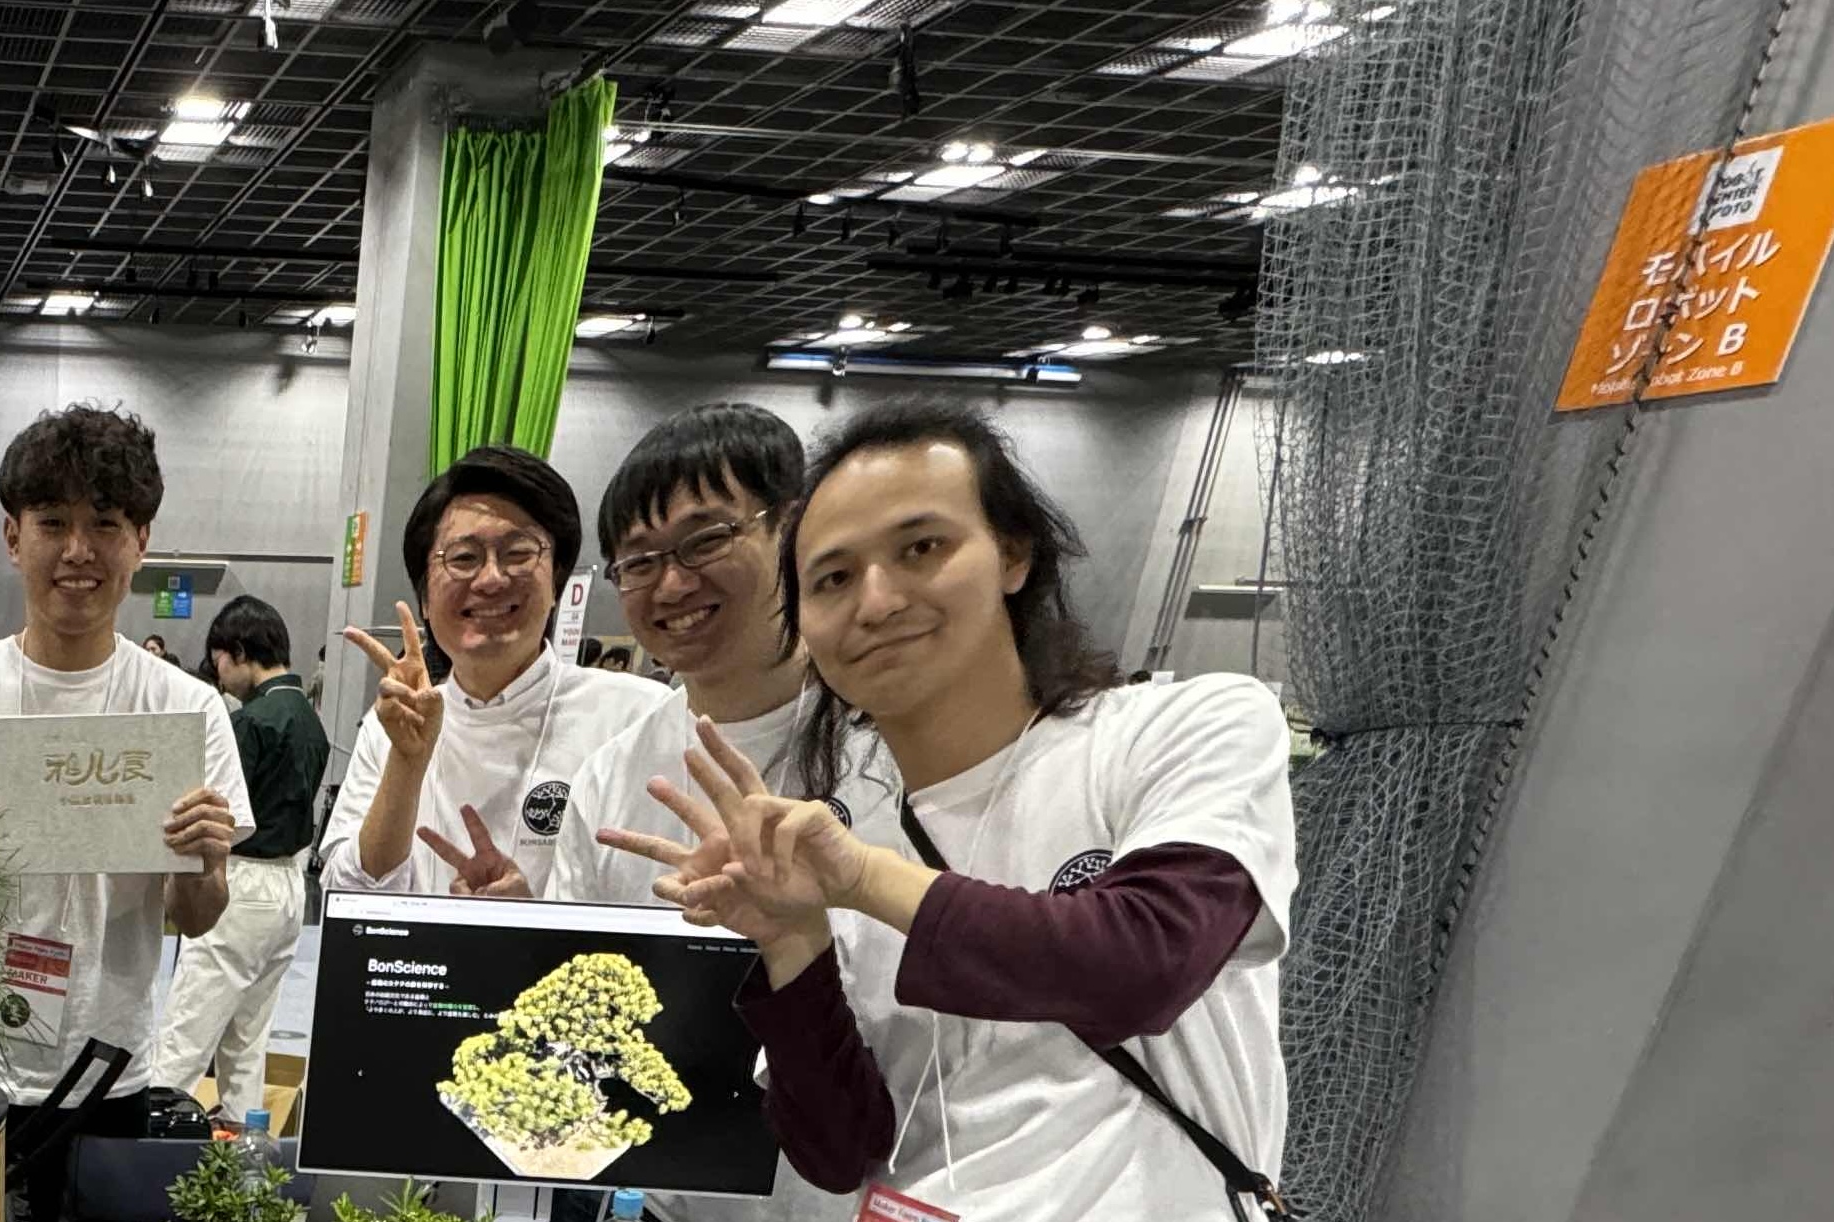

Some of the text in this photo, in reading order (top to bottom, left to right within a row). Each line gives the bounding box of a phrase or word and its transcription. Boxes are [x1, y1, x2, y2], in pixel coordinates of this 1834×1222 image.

[1708, 200, 1753, 220] YOTO
[1717, 322, 1748, 356] B
[1687, 366, 1727, 381] Zone
[1730, 361, 1744, 376] B
[571, 584, 584, 606] D
[367, 957, 448, 977] BonScience
